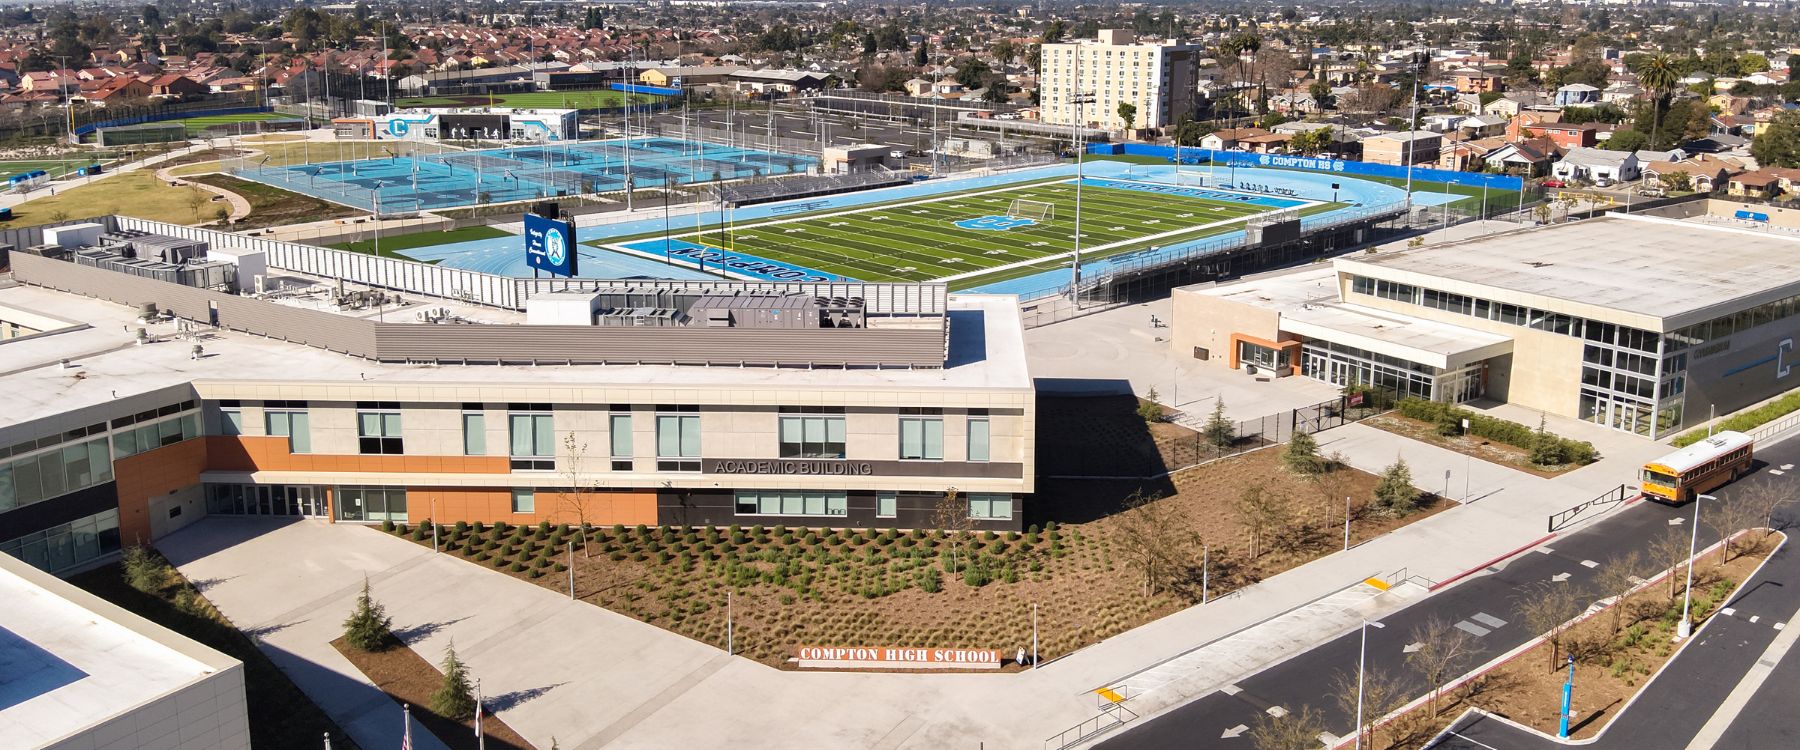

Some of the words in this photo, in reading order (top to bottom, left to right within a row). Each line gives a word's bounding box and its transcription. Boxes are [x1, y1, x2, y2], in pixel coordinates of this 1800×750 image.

[1272, 156, 1316, 169] COMPTON
[1318, 160, 1331, 170] HS
[714, 461, 797, 474] ACADEMIC
[800, 461, 872, 475] BUILDING
[800, 647, 878, 660] COMPTON
[885, 649, 927, 662] HIGH
[934, 650, 999, 663] SCHOOL
